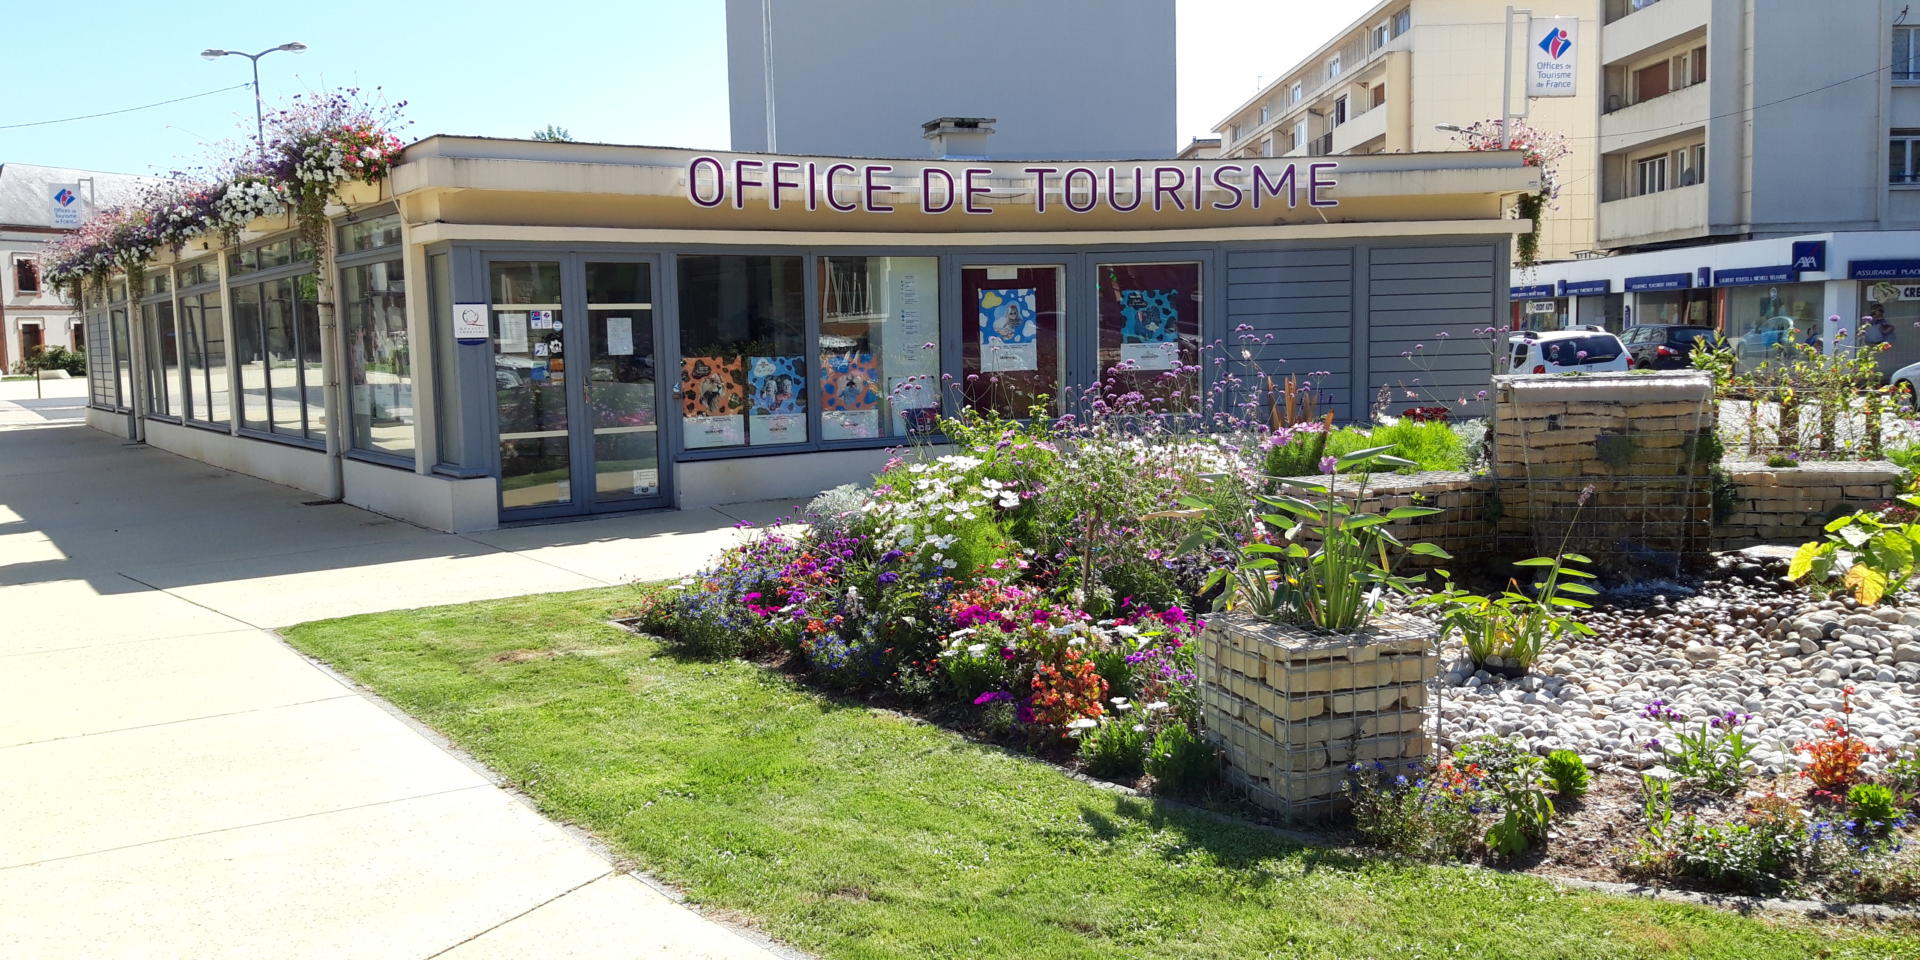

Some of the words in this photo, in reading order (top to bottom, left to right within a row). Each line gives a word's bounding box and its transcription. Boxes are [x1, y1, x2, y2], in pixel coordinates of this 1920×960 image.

[1537, 62, 1564, 70] Offices
[1537, 71, 1572, 79] Tourisme
[1546, 80, 1571, 88] France
[686, 156, 894, 213] OFFICE
[920, 166, 994, 215] DE
[1023, 161, 1340, 214] TOURISME
[1793, 256, 1817, 268] AXA
